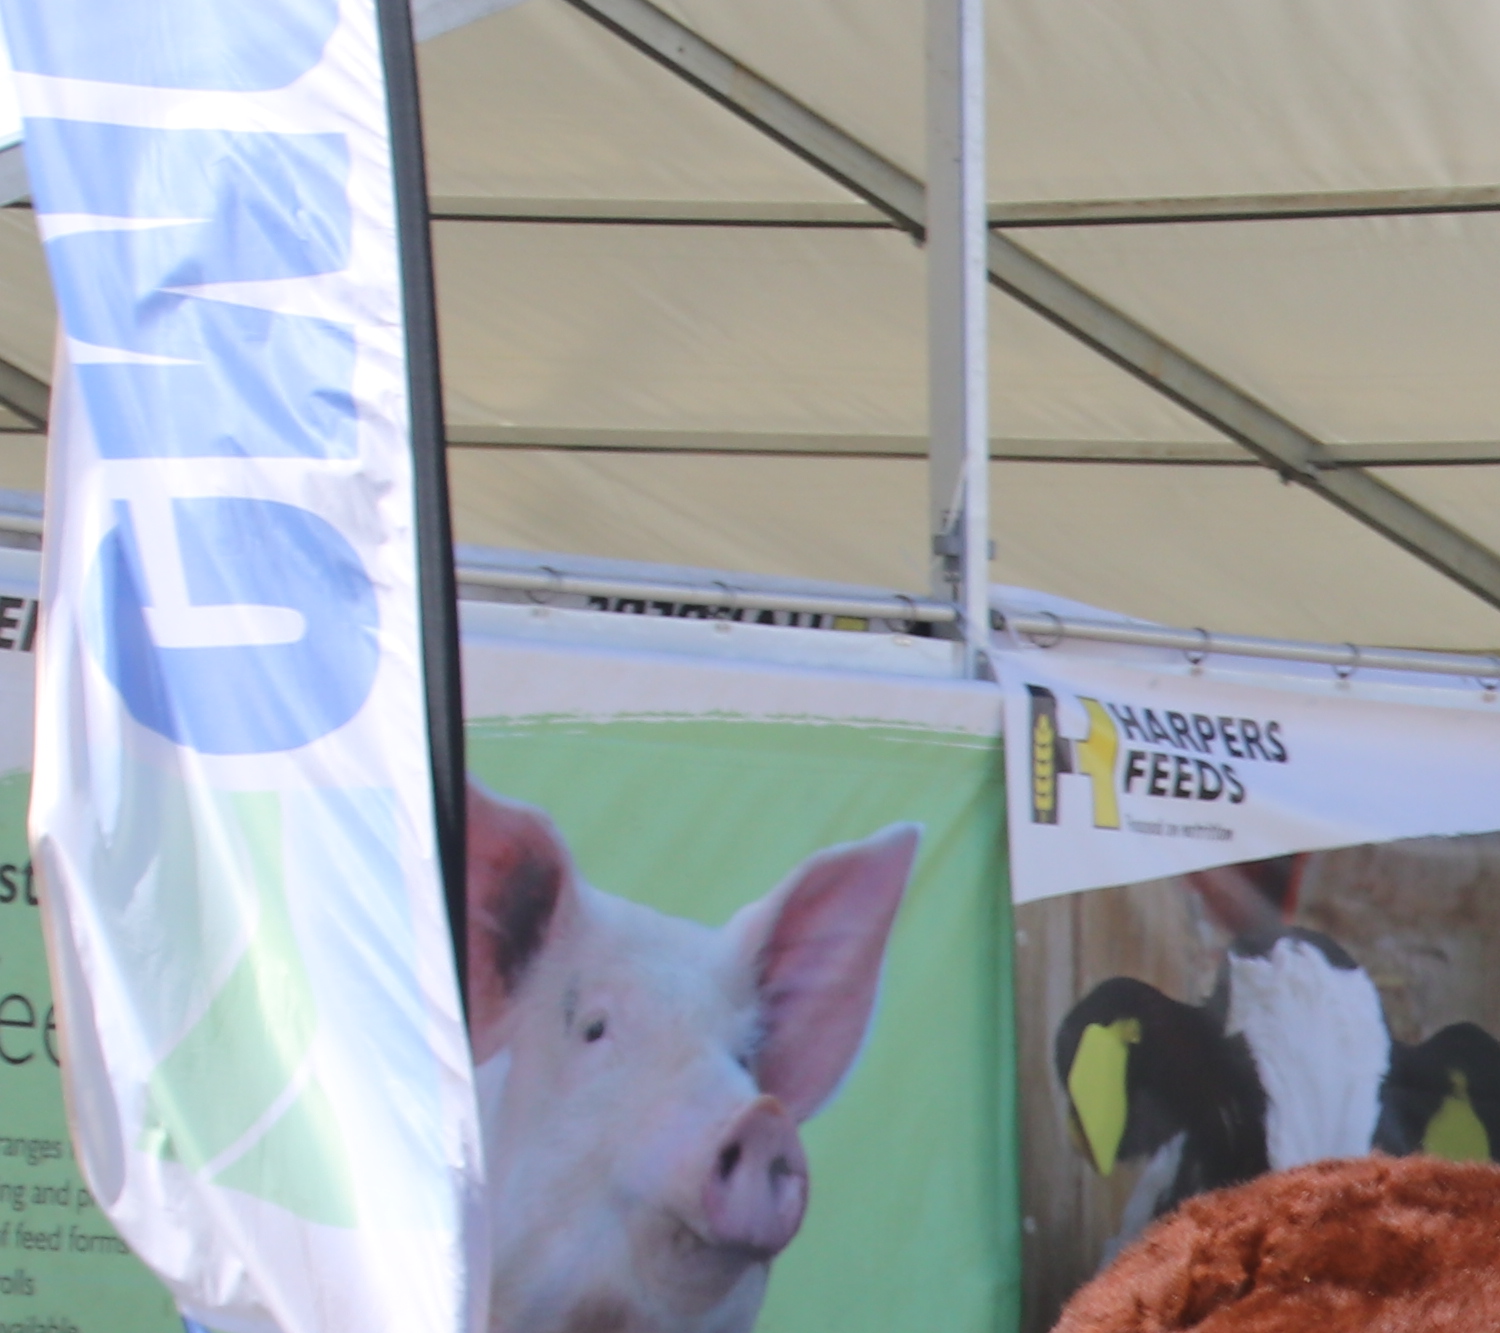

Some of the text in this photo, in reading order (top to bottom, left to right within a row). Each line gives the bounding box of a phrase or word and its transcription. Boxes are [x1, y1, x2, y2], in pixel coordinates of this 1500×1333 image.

[1107, 702, 1288, 763] HARPERS
[1124, 750, 1246, 804] FEEDS
[15, 1222, 61, 1252] feed
